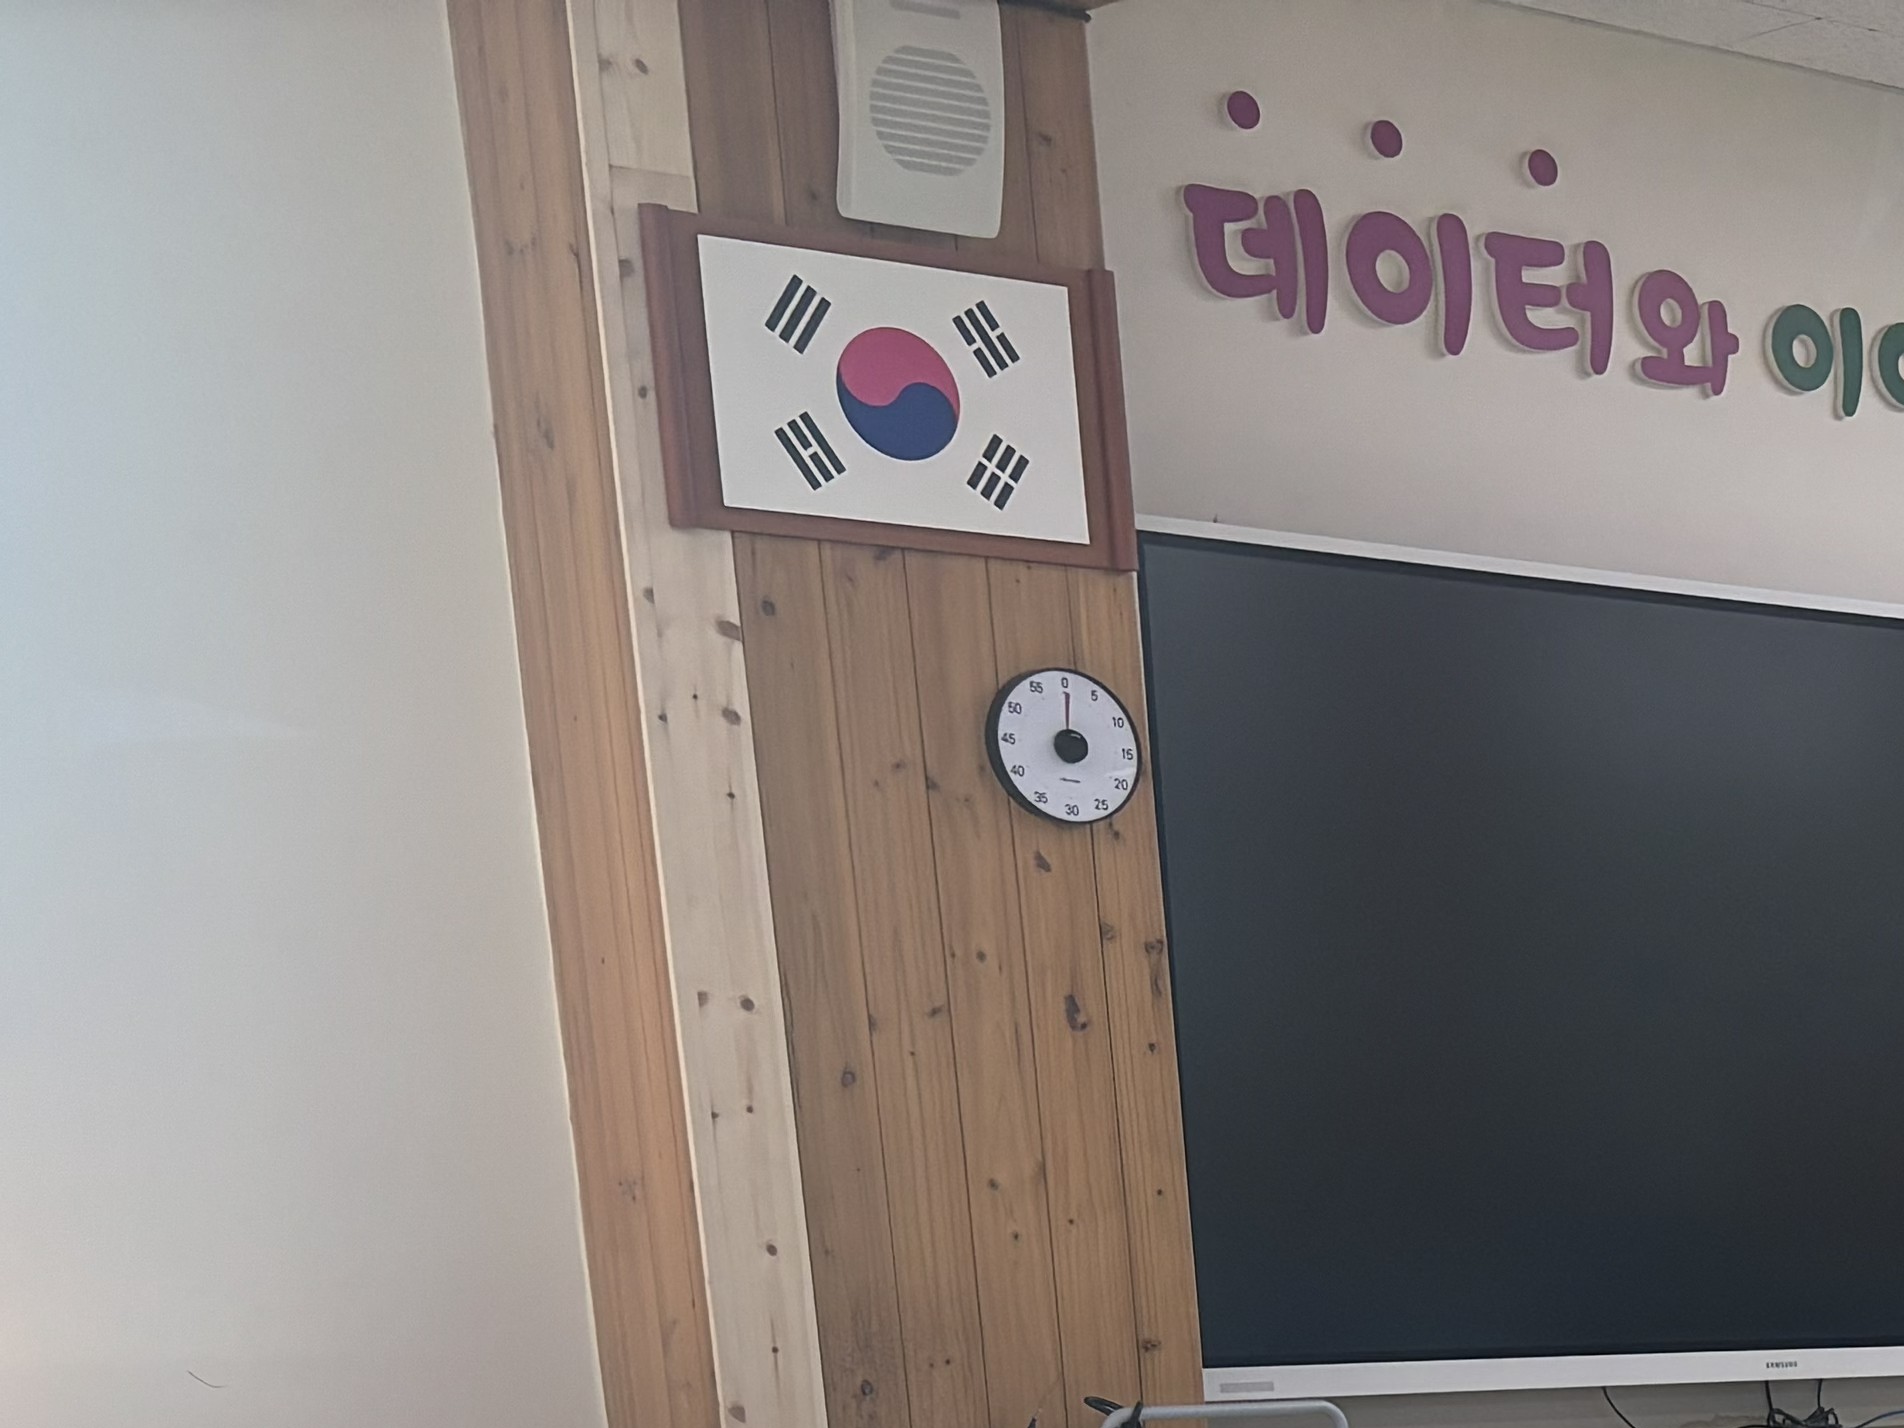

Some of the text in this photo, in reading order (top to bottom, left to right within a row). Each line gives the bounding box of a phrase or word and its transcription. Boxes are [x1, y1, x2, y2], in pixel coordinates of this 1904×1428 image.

[1184, 184, 1739, 396] 데이터와
[1029, 680, 1043, 694] 55
[1061, 677, 1069, 688] 0
[1091, 690, 1099, 701] 5
[1007, 701, 1022, 715] 50
[1112, 716, 1125, 728] 10
[1001, 732, 1016, 745] 45
[1121, 748, 1134, 761] 15
[1010, 765, 1025, 777] 40
[1114, 778, 1128, 791] 20
[1034, 791, 1049, 804] 35
[1065, 804, 1080, 816] 30
[1094, 798, 1109, 811] 25
